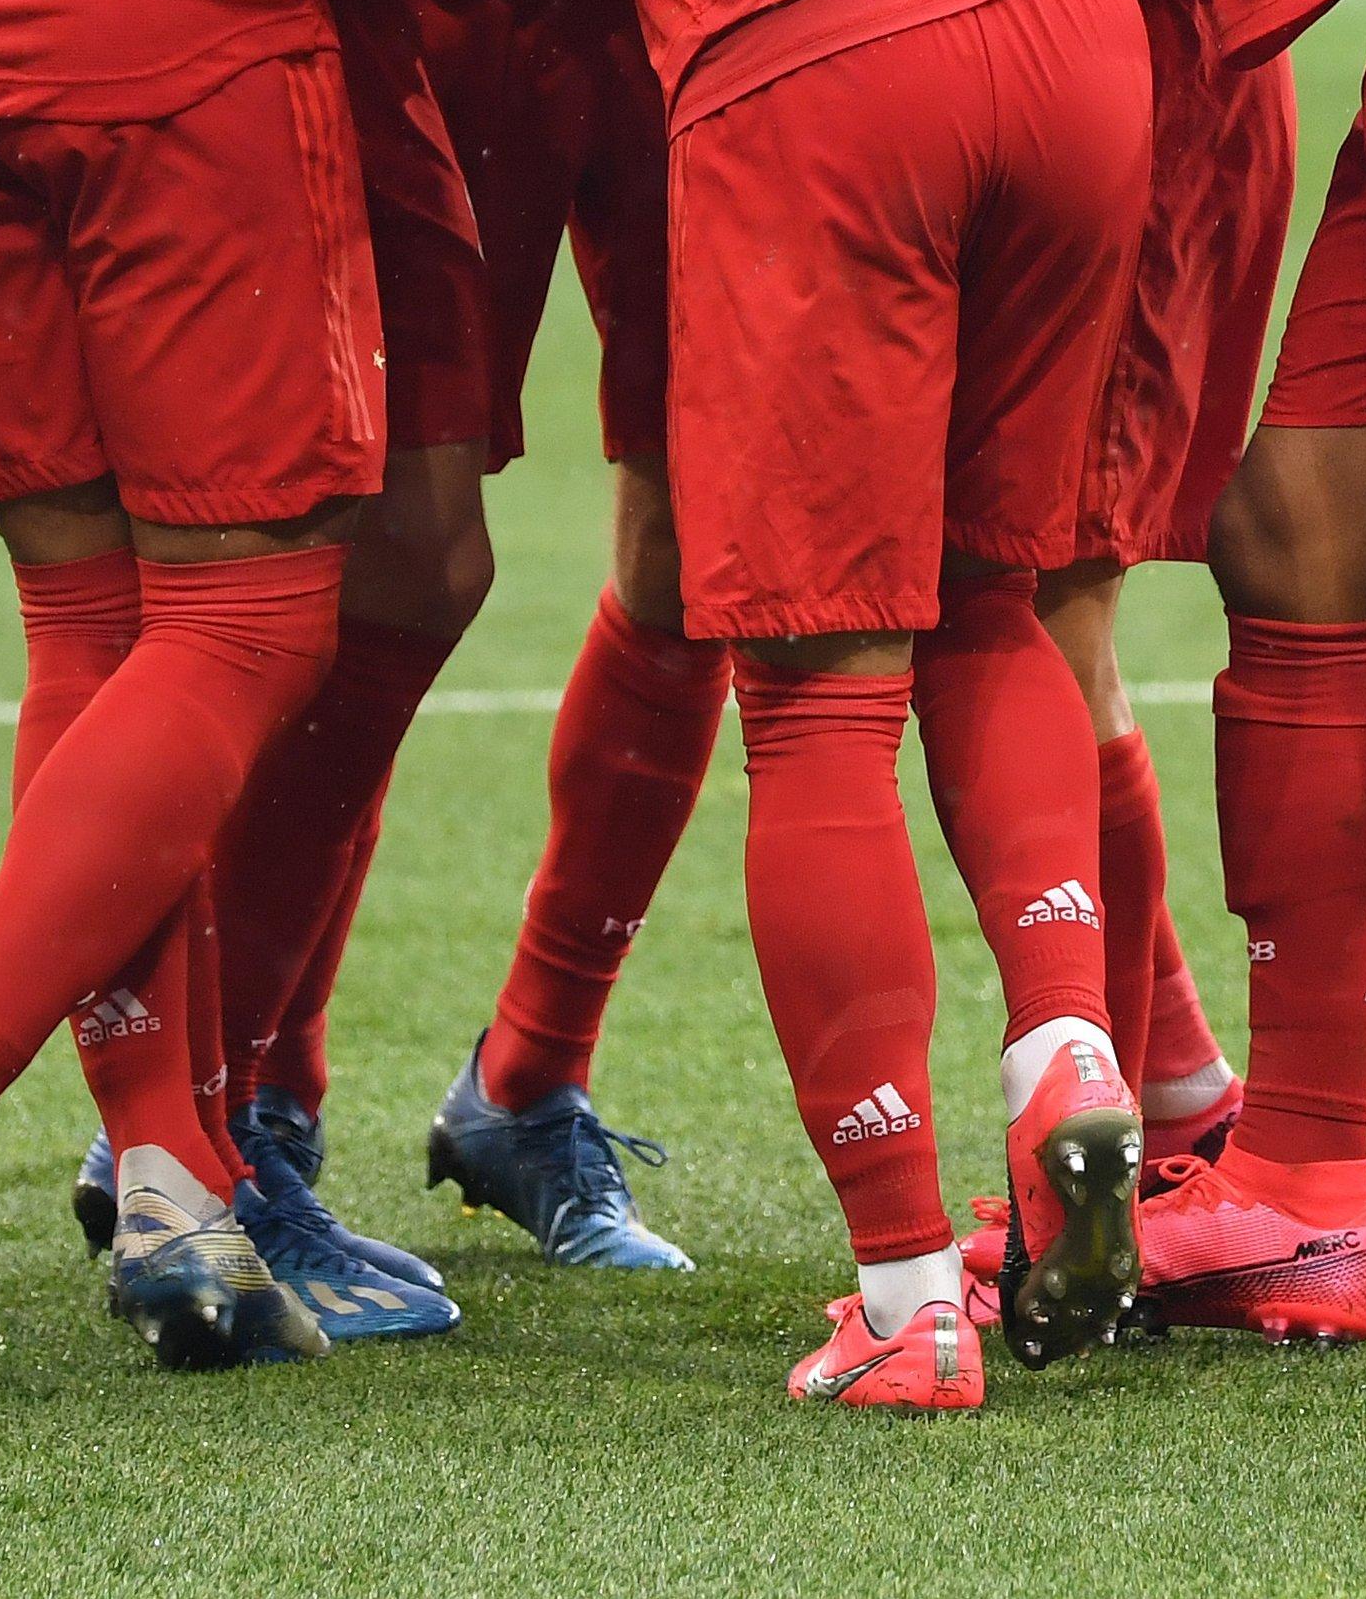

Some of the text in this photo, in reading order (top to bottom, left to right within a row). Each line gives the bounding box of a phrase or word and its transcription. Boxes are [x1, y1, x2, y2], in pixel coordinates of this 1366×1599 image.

[1017, 907, 1101, 931] adidas
[77, 1016, 162, 1047] adidas
[832, 1113, 922, 1145] adidas
